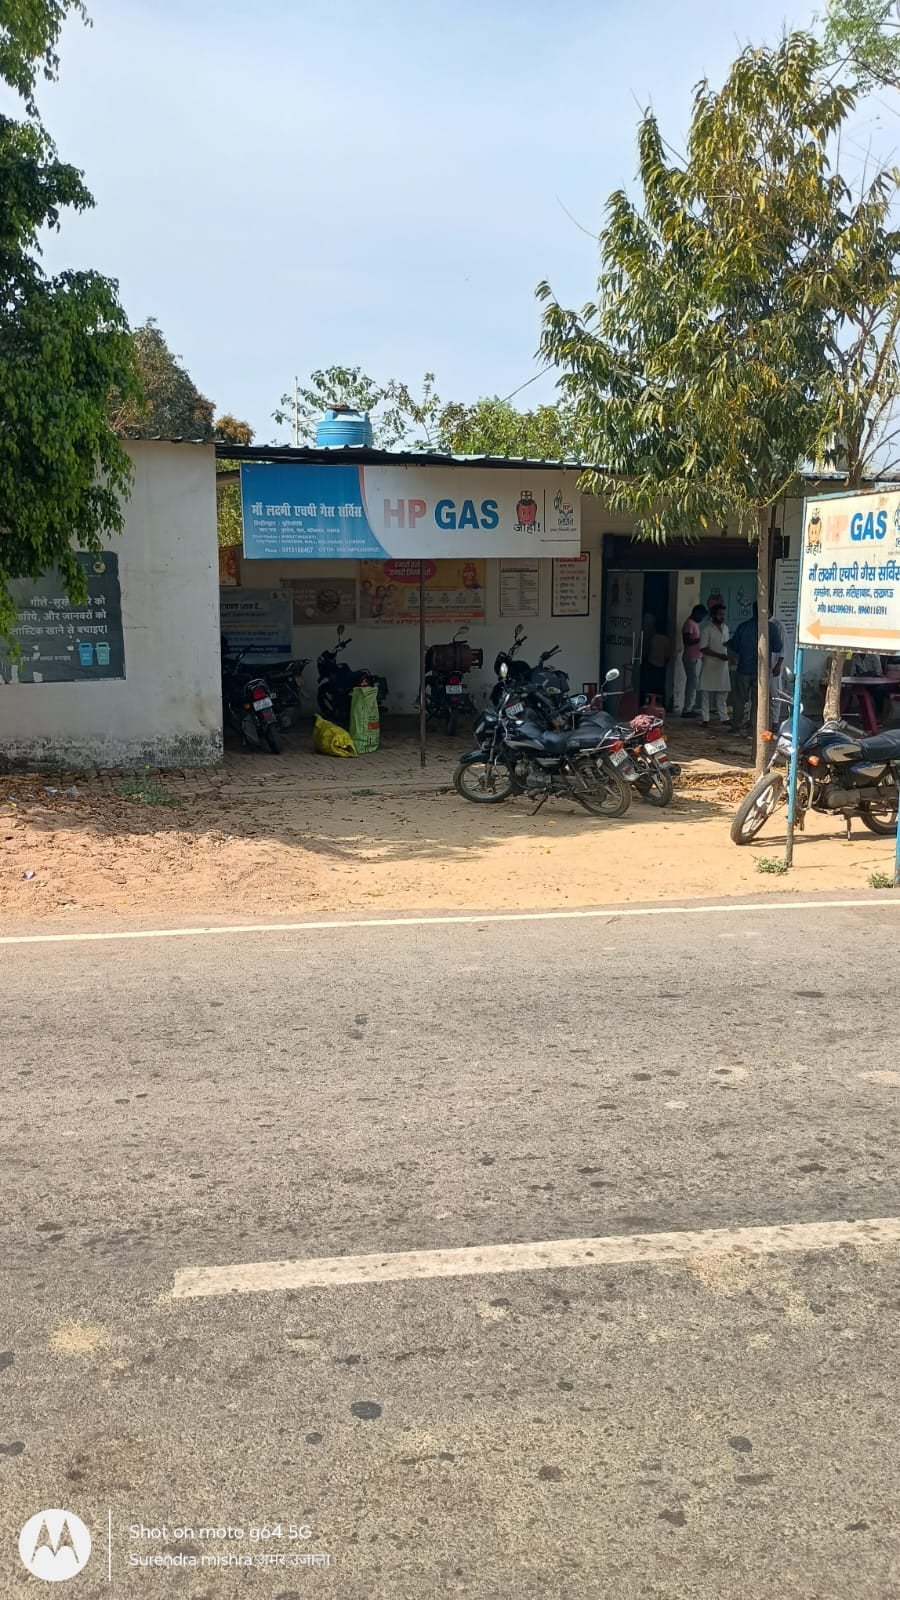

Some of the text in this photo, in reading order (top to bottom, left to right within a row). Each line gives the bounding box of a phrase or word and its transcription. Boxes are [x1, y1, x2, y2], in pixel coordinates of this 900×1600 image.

[294, 502, 318, 516] एचपी
[338, 502, 362, 518] सर्विस
[384, 498, 500, 530] HP GAS
[850, 510, 888, 542] GAS
[840, 560, 858, 582] एचपी
[94, 596, 106, 606] को
[44, 610, 60, 620] और
[62, 610, 94, 620] जानवरों
[96, 608, 106, 618] को
[68, 624, 74, 634] से
